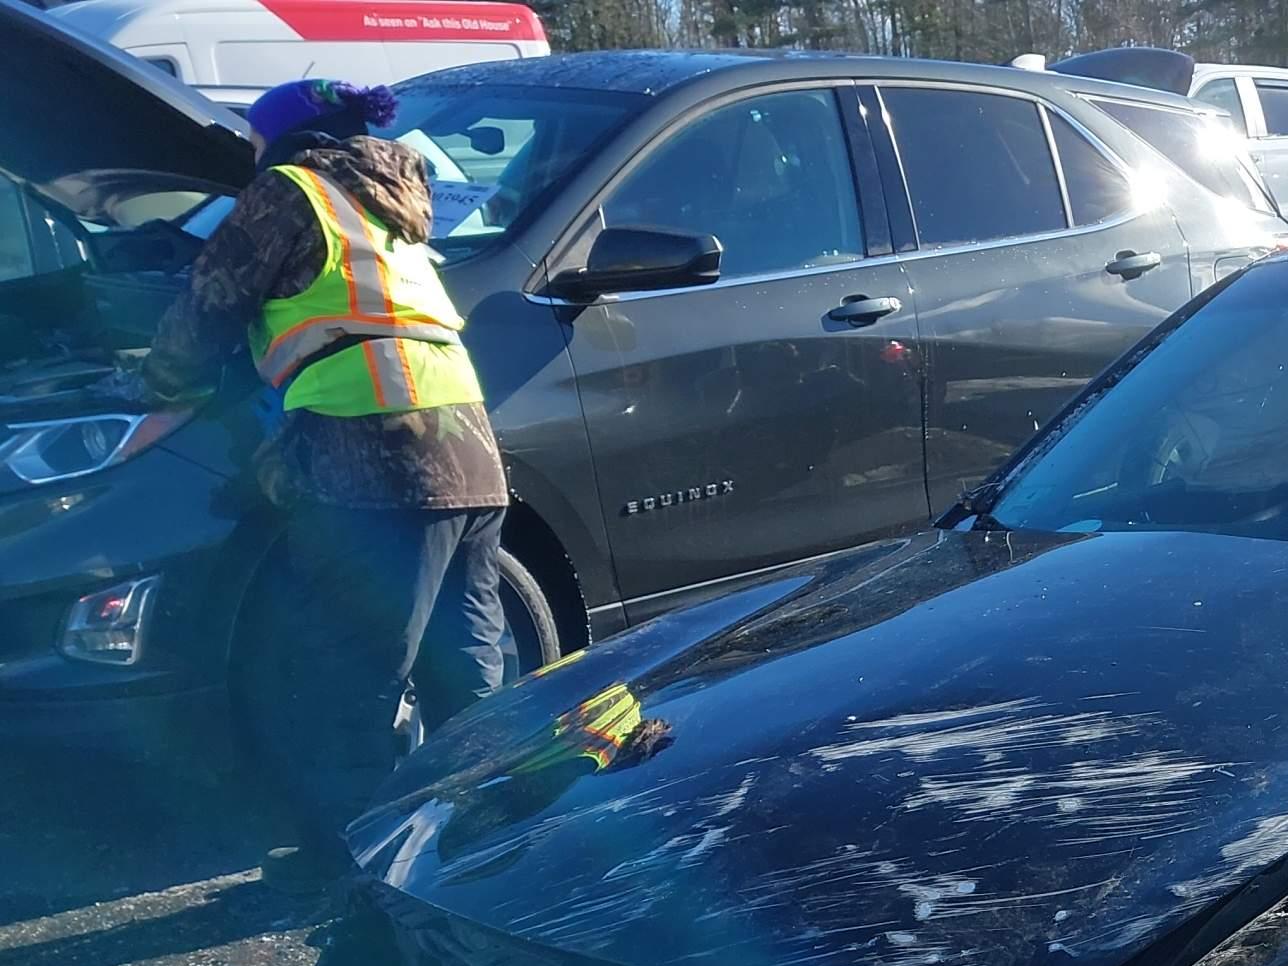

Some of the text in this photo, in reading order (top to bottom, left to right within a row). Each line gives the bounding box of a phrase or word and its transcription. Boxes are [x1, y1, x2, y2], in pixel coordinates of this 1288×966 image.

[378, 17, 403, 28] seen
[404, 18, 418, 28] on
[442, 17, 461, 30] this
[461, 18, 480, 30] Old
[627, 480, 735, 513] EQUINOX
